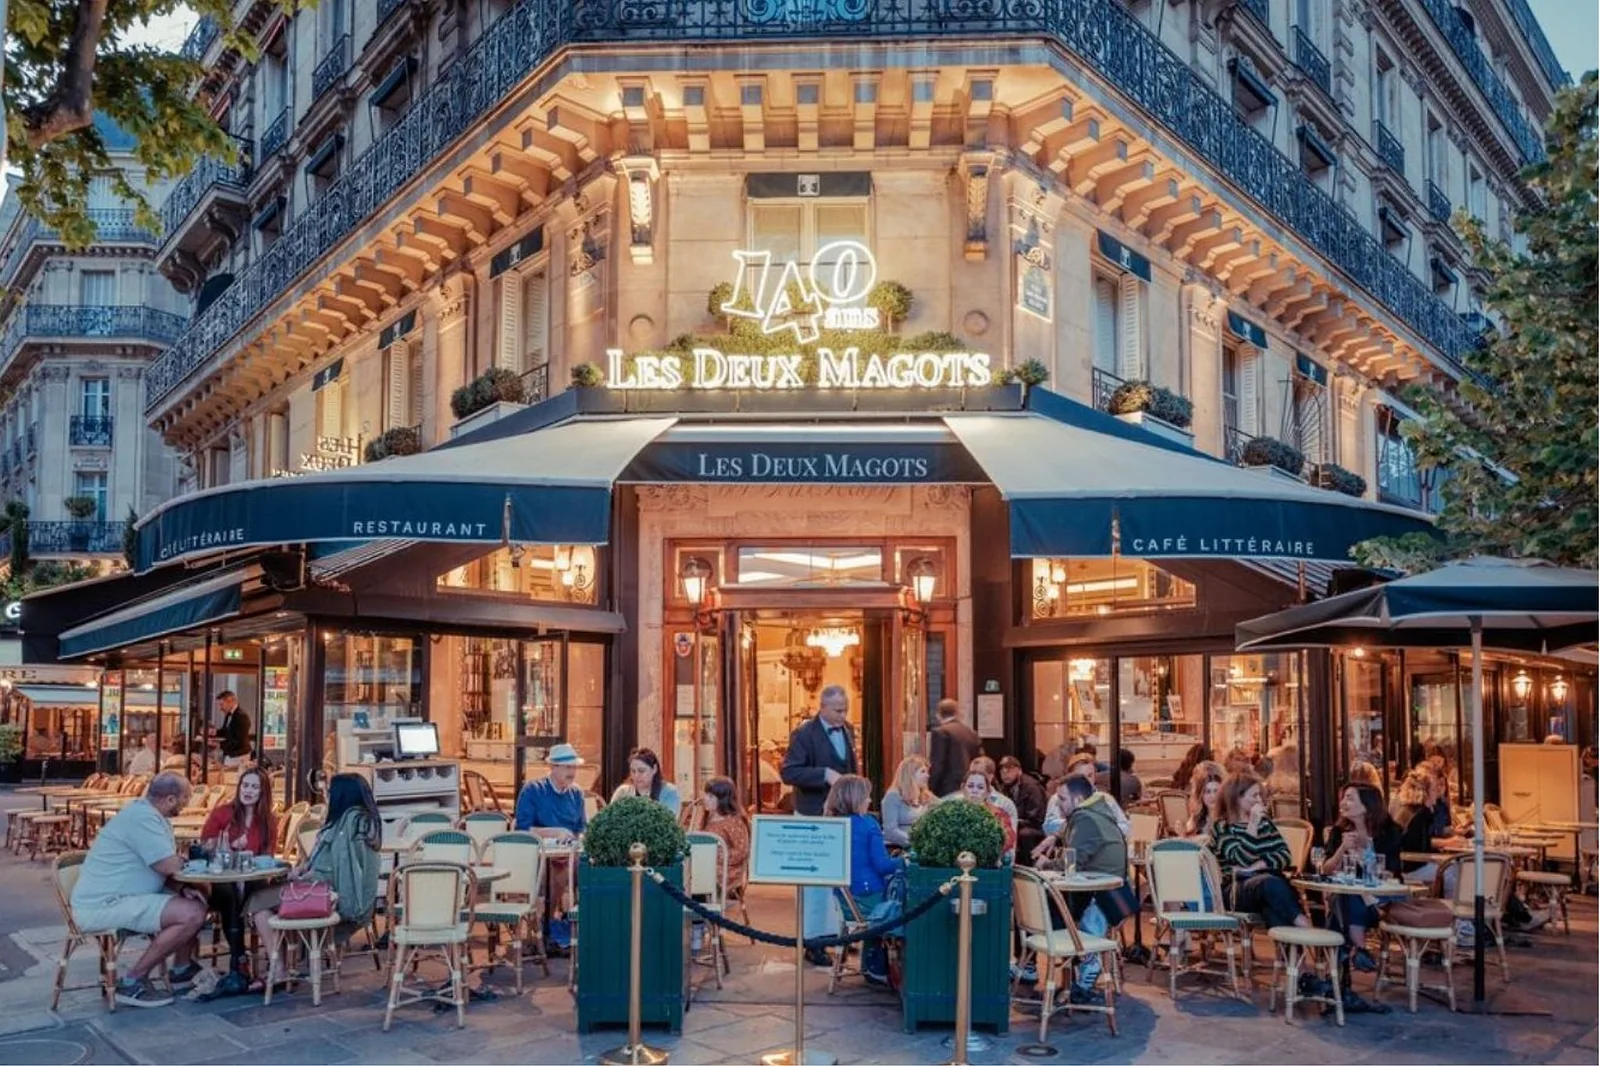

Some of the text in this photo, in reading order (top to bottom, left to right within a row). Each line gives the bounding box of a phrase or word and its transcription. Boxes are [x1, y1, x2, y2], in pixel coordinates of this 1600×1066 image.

[720, 240, 878, 344] 140
[353, 520, 487, 536] RESTAURANT
[1132, 535, 1315, 555] CAFÉ LITTÉRAIRE
